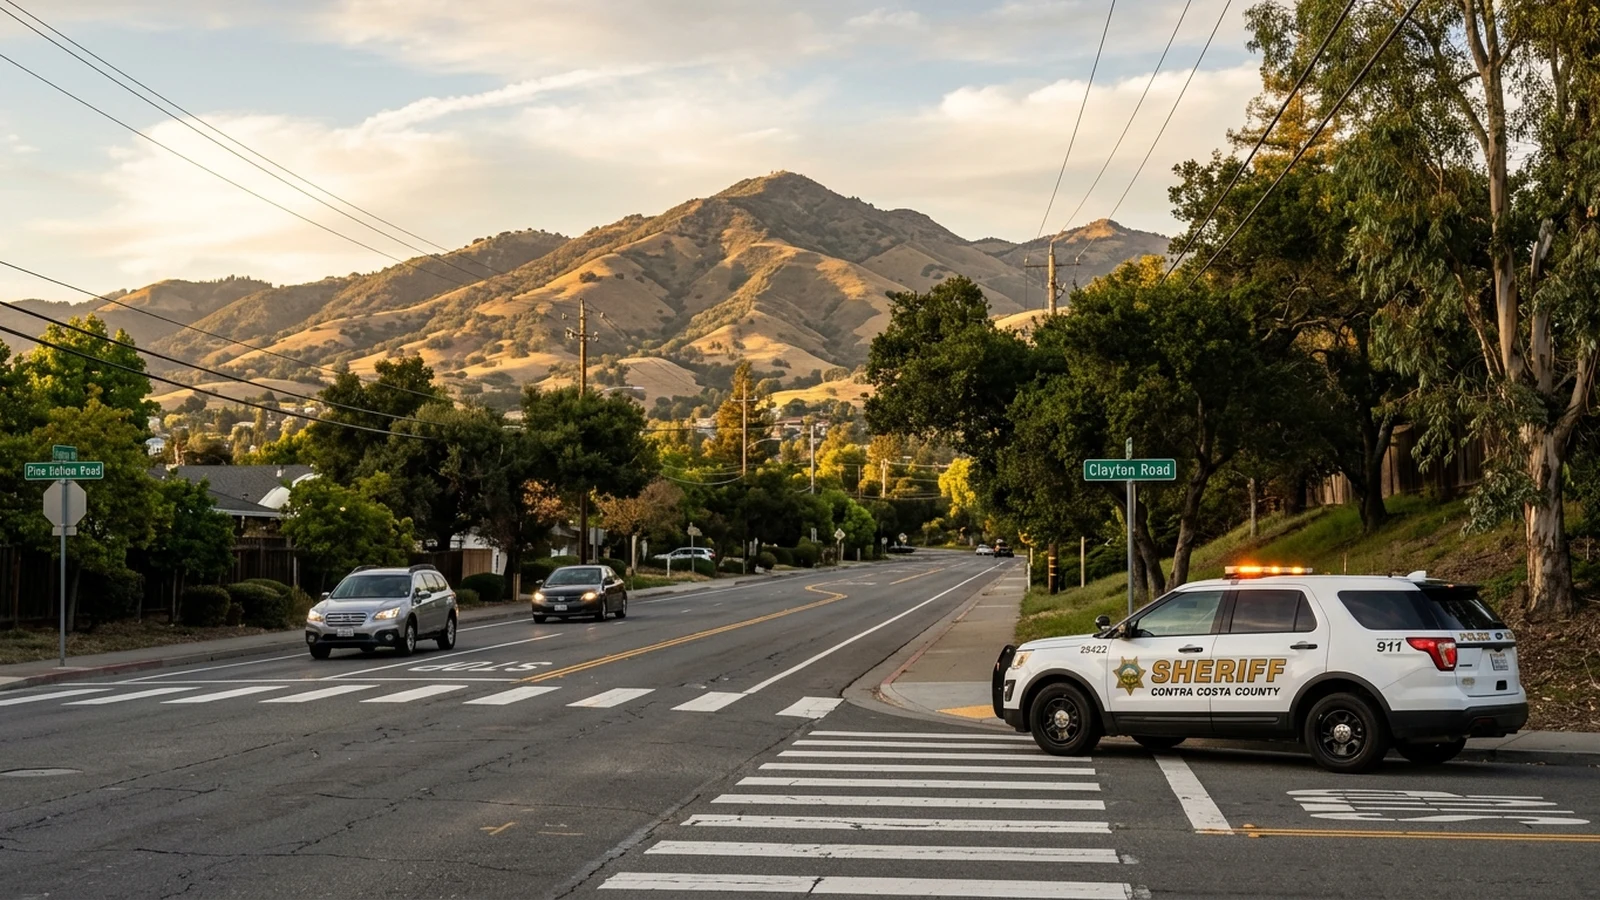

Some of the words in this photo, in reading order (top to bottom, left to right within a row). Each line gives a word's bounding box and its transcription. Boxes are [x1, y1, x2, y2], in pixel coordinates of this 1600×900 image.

[1089, 463, 1135, 478] Clayton
[1141, 463, 1170, 475] Road
[1377, 641, 1401, 652] 911
[1150, 658, 1287, 684] SHERIFF
[1151, 687, 1193, 697] CONTRA
[1196, 687, 1231, 697] COSTA
[1235, 687, 1281, 697] COUNTY
